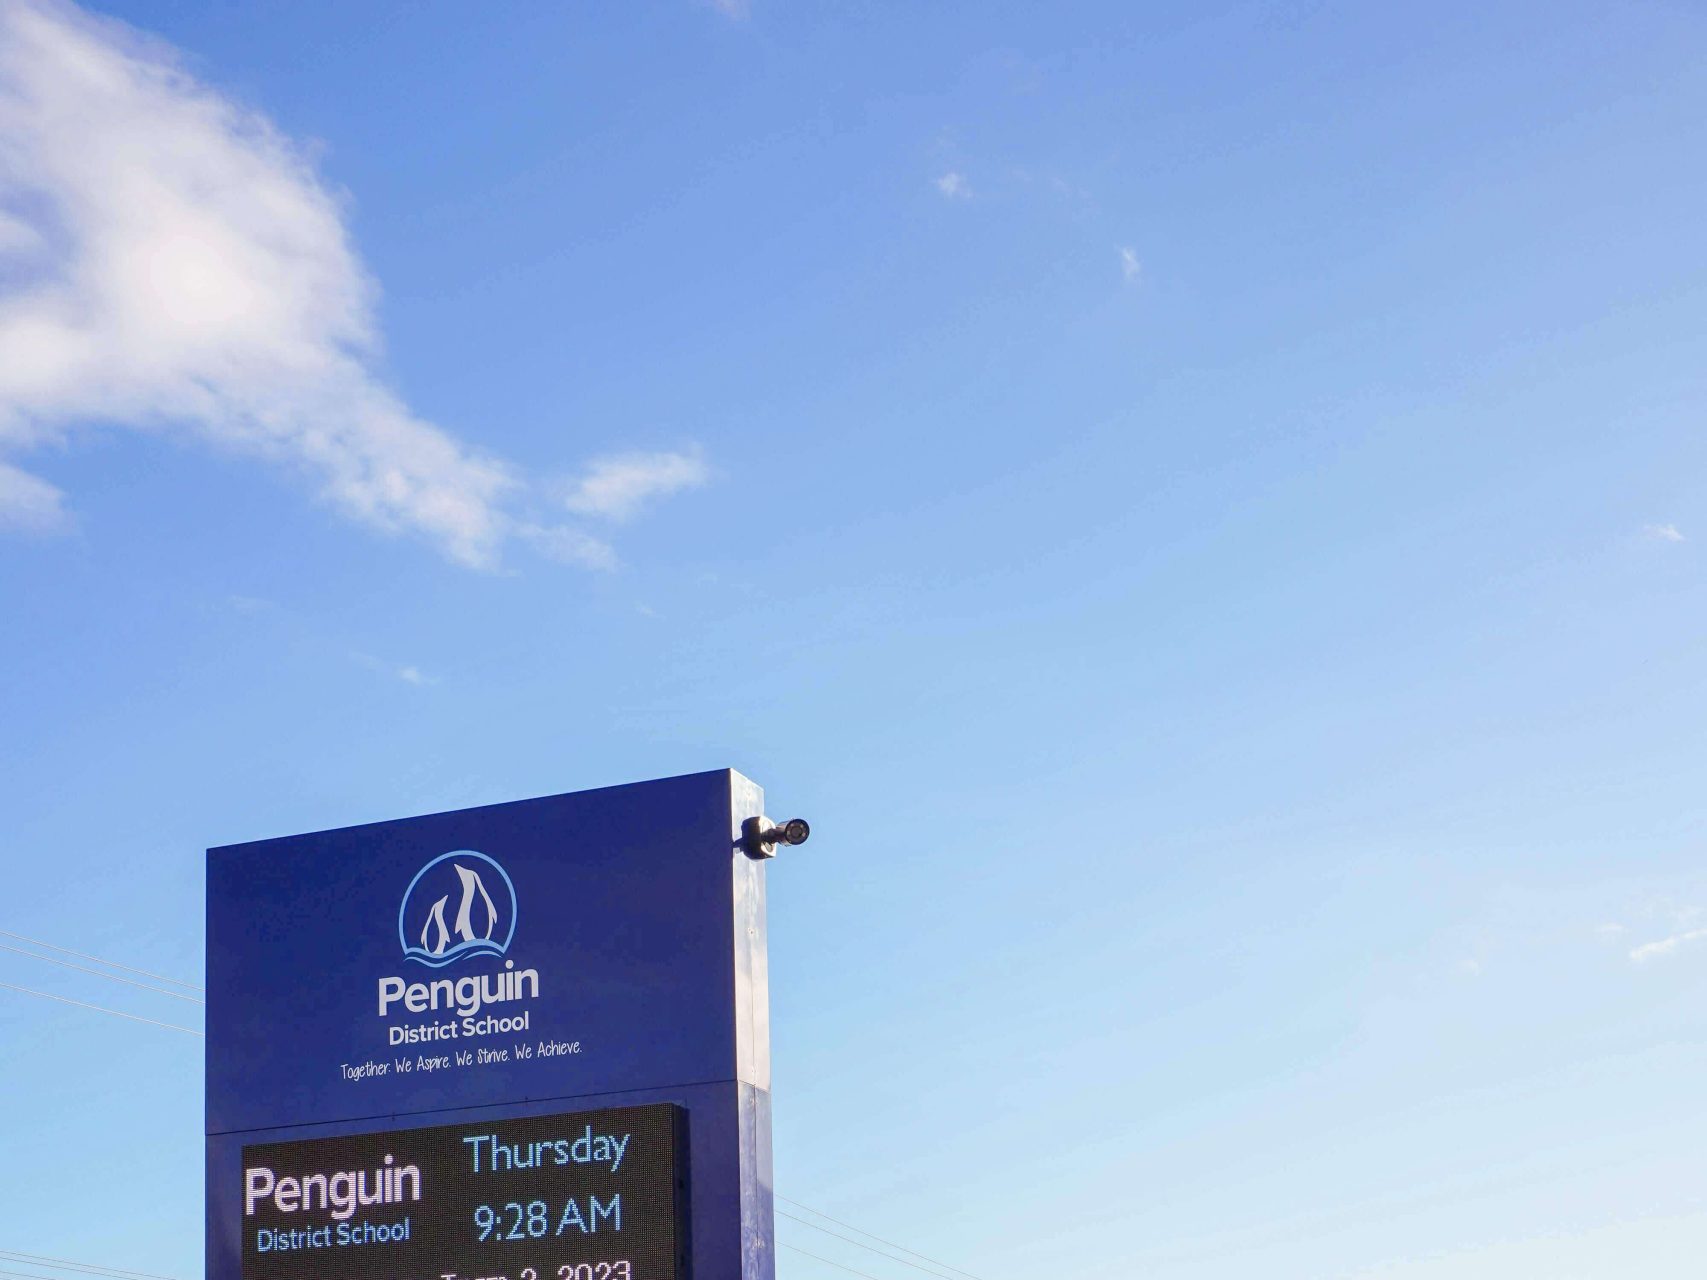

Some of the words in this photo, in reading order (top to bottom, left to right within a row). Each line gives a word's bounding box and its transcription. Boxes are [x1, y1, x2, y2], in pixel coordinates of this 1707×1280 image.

[378, 959, 540, 1018] Penguin
[389, 1020, 458, 1046] District
[462, 1010, 530, 1037] School
[395, 1056, 412, 1073] We
[416, 1055, 451, 1073] Aspire.
[456, 1050, 473, 1067] We
[477, 1048, 511, 1064] Strive.
[515, 1043, 533, 1060] We
[537, 1039, 583, 1058] Achieve.
[463, 1125, 631, 1172] Thursday
[244, 1153, 422, 1220] Penguin
[256, 1226, 334, 1253] District
[336, 1216, 411, 1246] School
[473, 1199, 548, 1243] 9:28
[555, 1193, 623, 1236] AM
